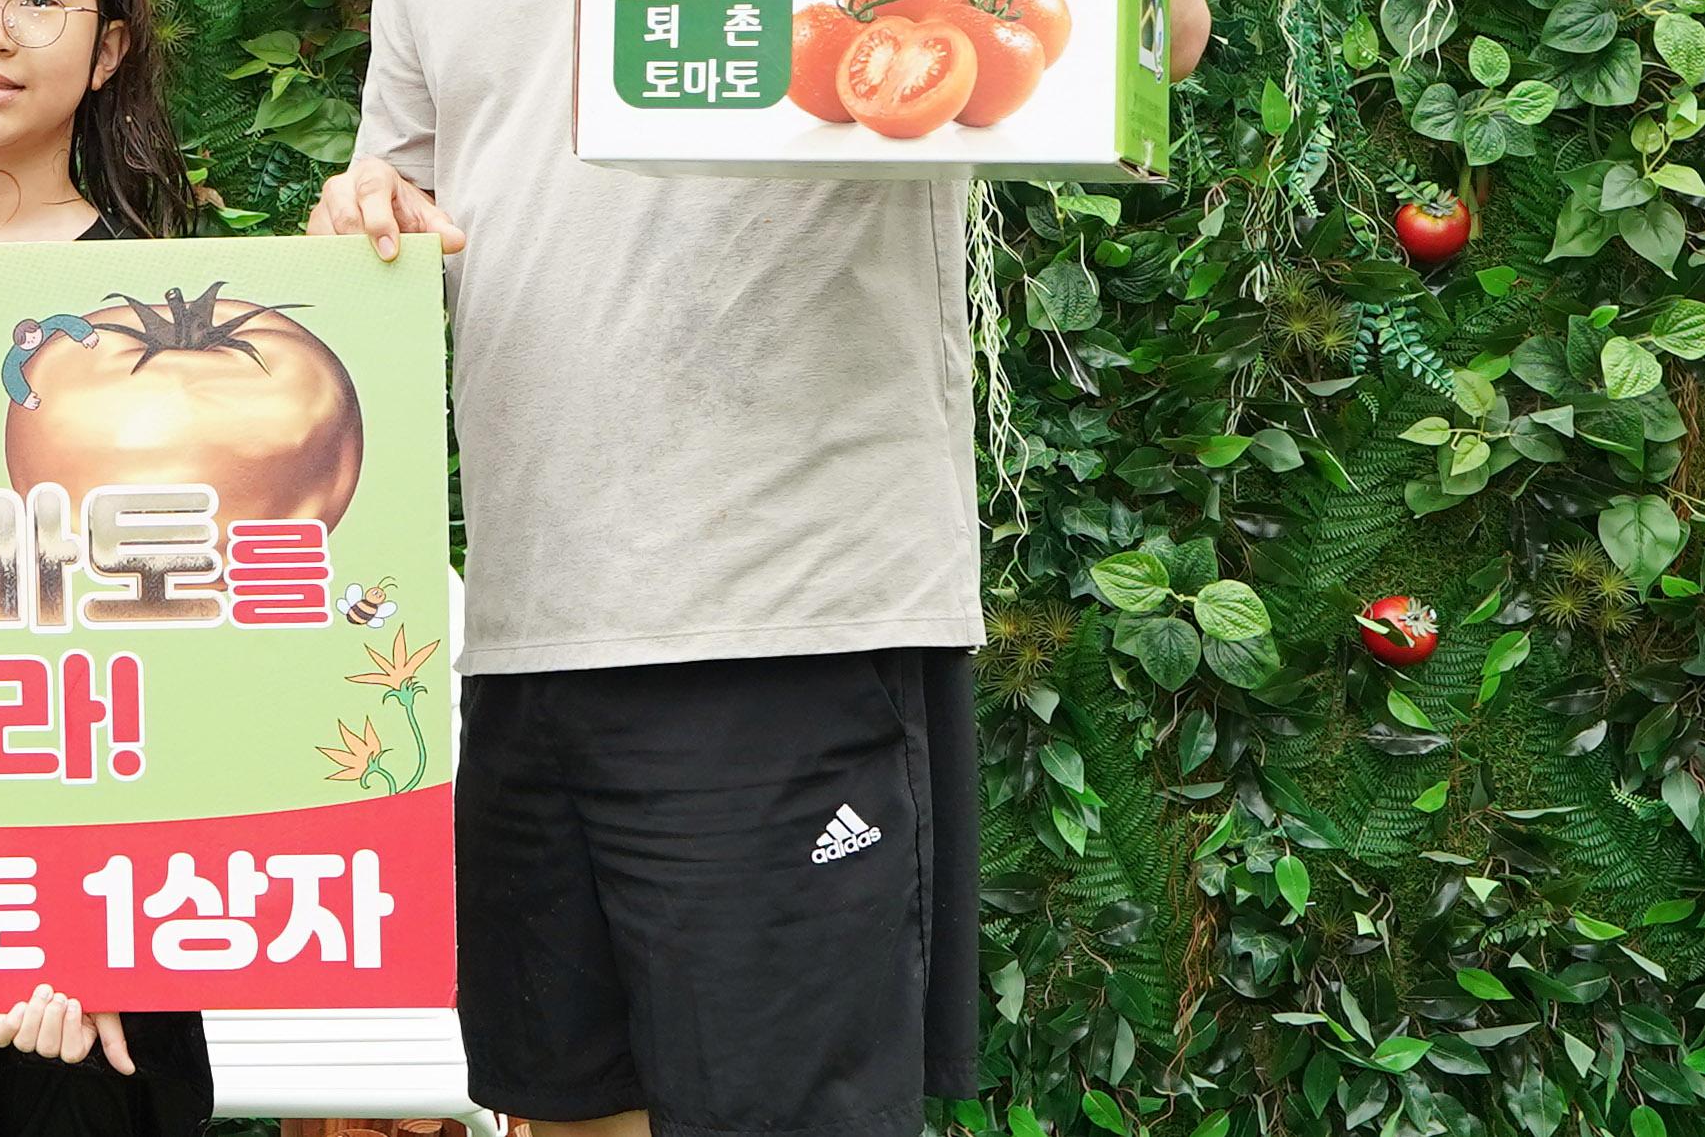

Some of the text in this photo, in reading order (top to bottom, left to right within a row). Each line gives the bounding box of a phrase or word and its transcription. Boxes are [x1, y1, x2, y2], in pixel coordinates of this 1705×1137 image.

[642, 58, 761, 103] 토마토
[810, 826, 882, 864] adidas
[82, 848, 396, 972] 1상자
